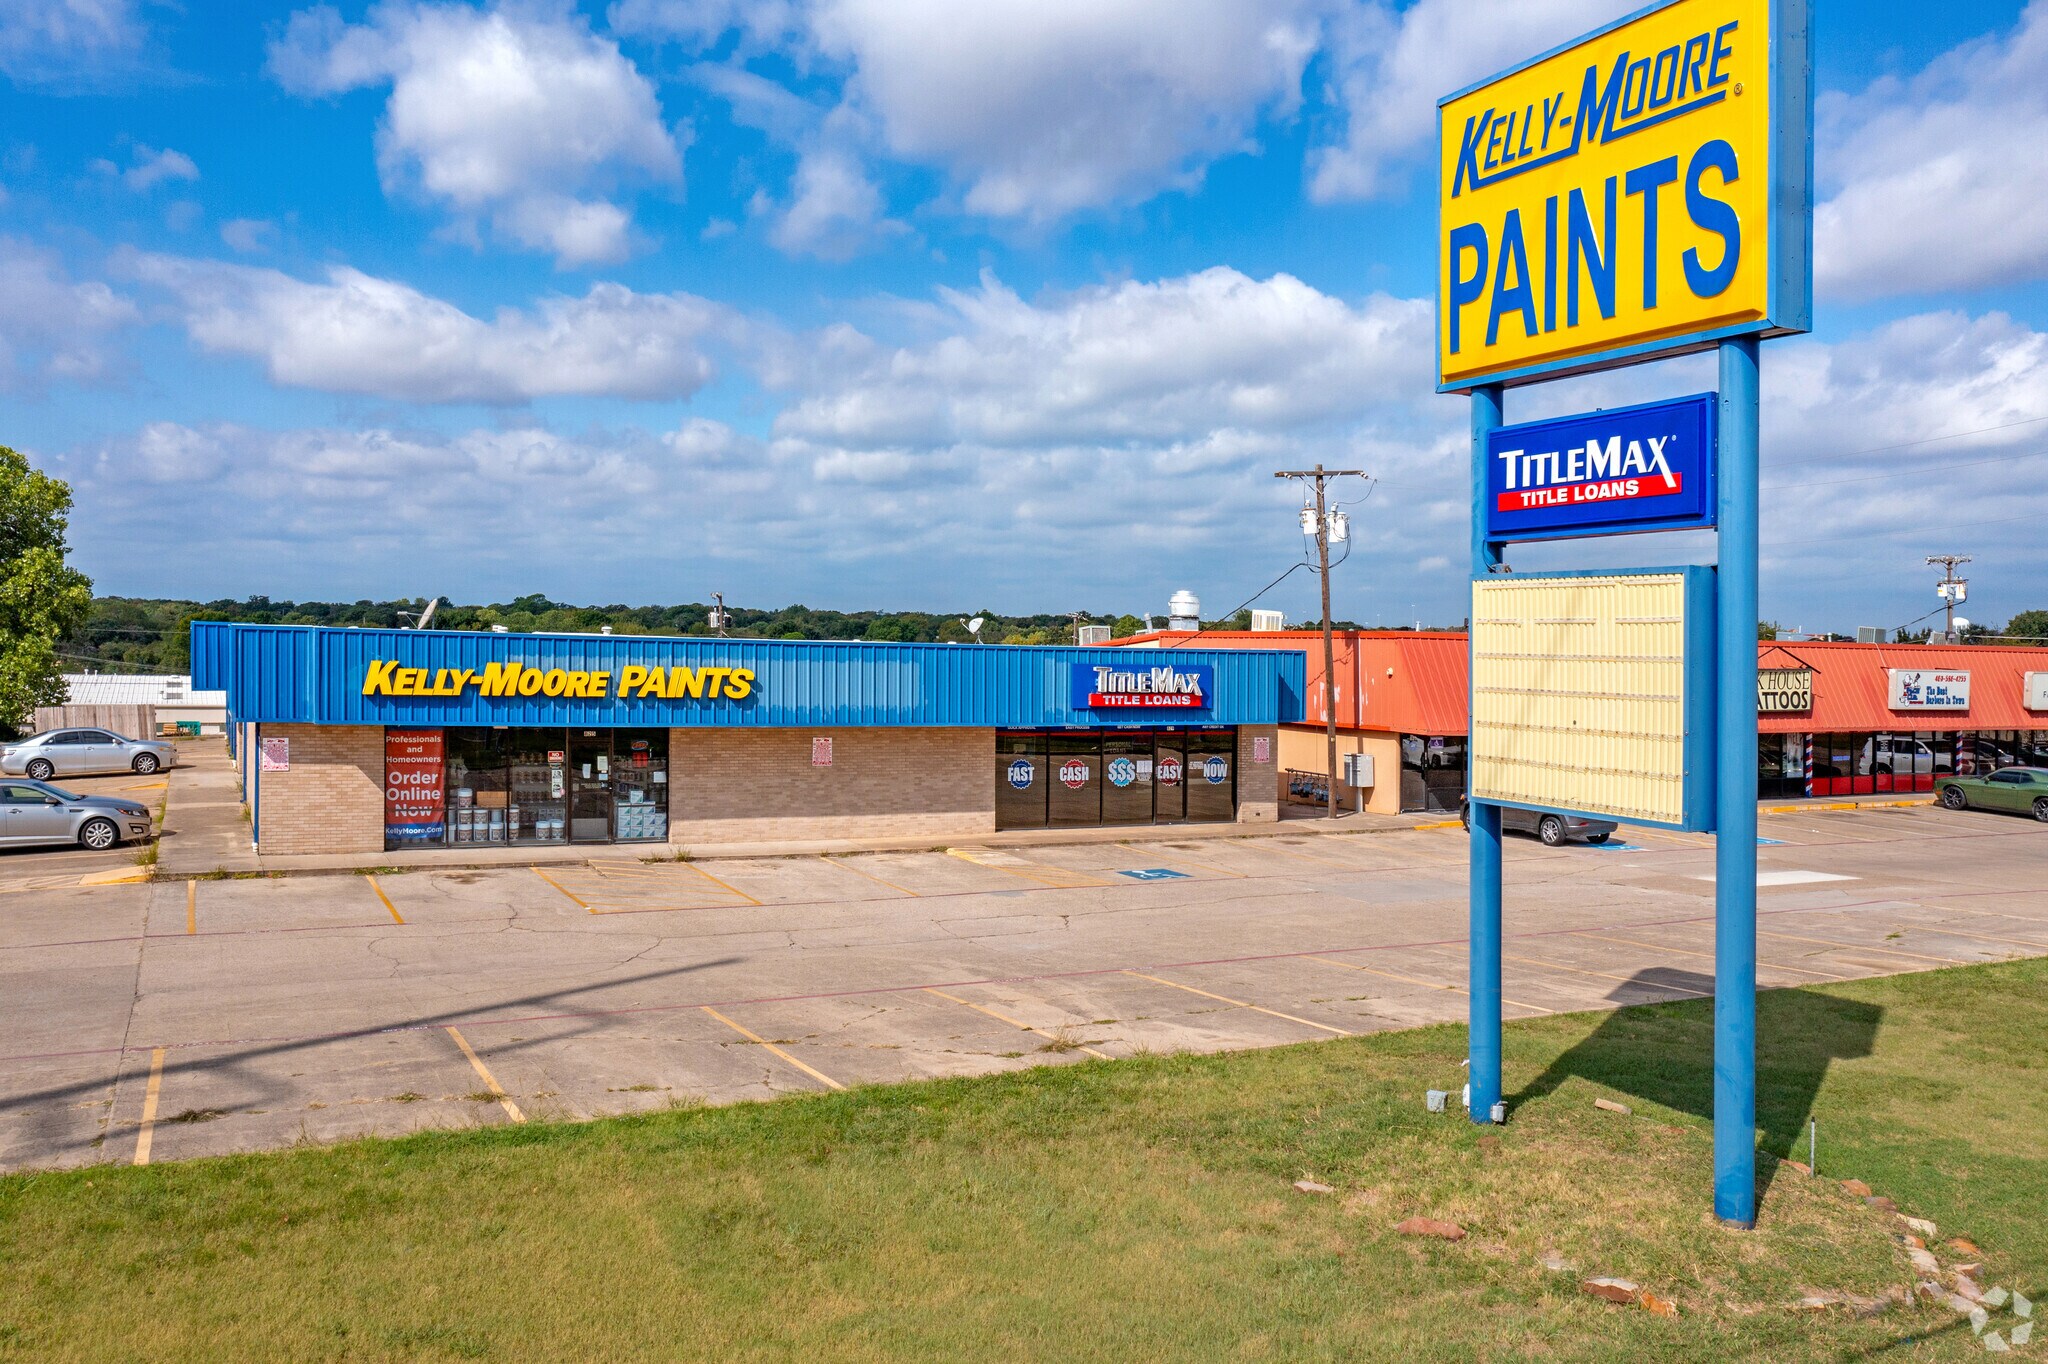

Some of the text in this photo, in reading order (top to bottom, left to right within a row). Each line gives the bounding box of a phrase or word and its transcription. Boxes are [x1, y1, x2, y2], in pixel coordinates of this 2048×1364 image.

[1451, 20, 1739, 199] KELLY-MOORE
[1450, 139, 1740, 354] PAINTS
[1499, 435, 1677, 489] TITLEMAX
[1521, 480, 1639, 507] TITLE LOANS
[362, 660, 755, 699] KELLY-MOORE PAINTS
[1093, 665, 1203, 696] TITLEMAX
[1768, 671, 1810, 690] HOUSE
[1103, 695, 1191, 705] TITLE LOANS
[1757, 691, 1808, 709] ATTOOS
[386, 735, 442, 743] Professionals
[389, 771, 439, 785] Order
[1007, 766, 1035, 782] FAST
[1060, 766, 1090, 782] CASH
[1108, 761, 1136, 782] $$$
[1157, 765, 1183, 779] EASY
[1203, 764, 1228, 778] NOW
[386, 787, 441, 801] Online
[395, 803, 433, 817] Now
